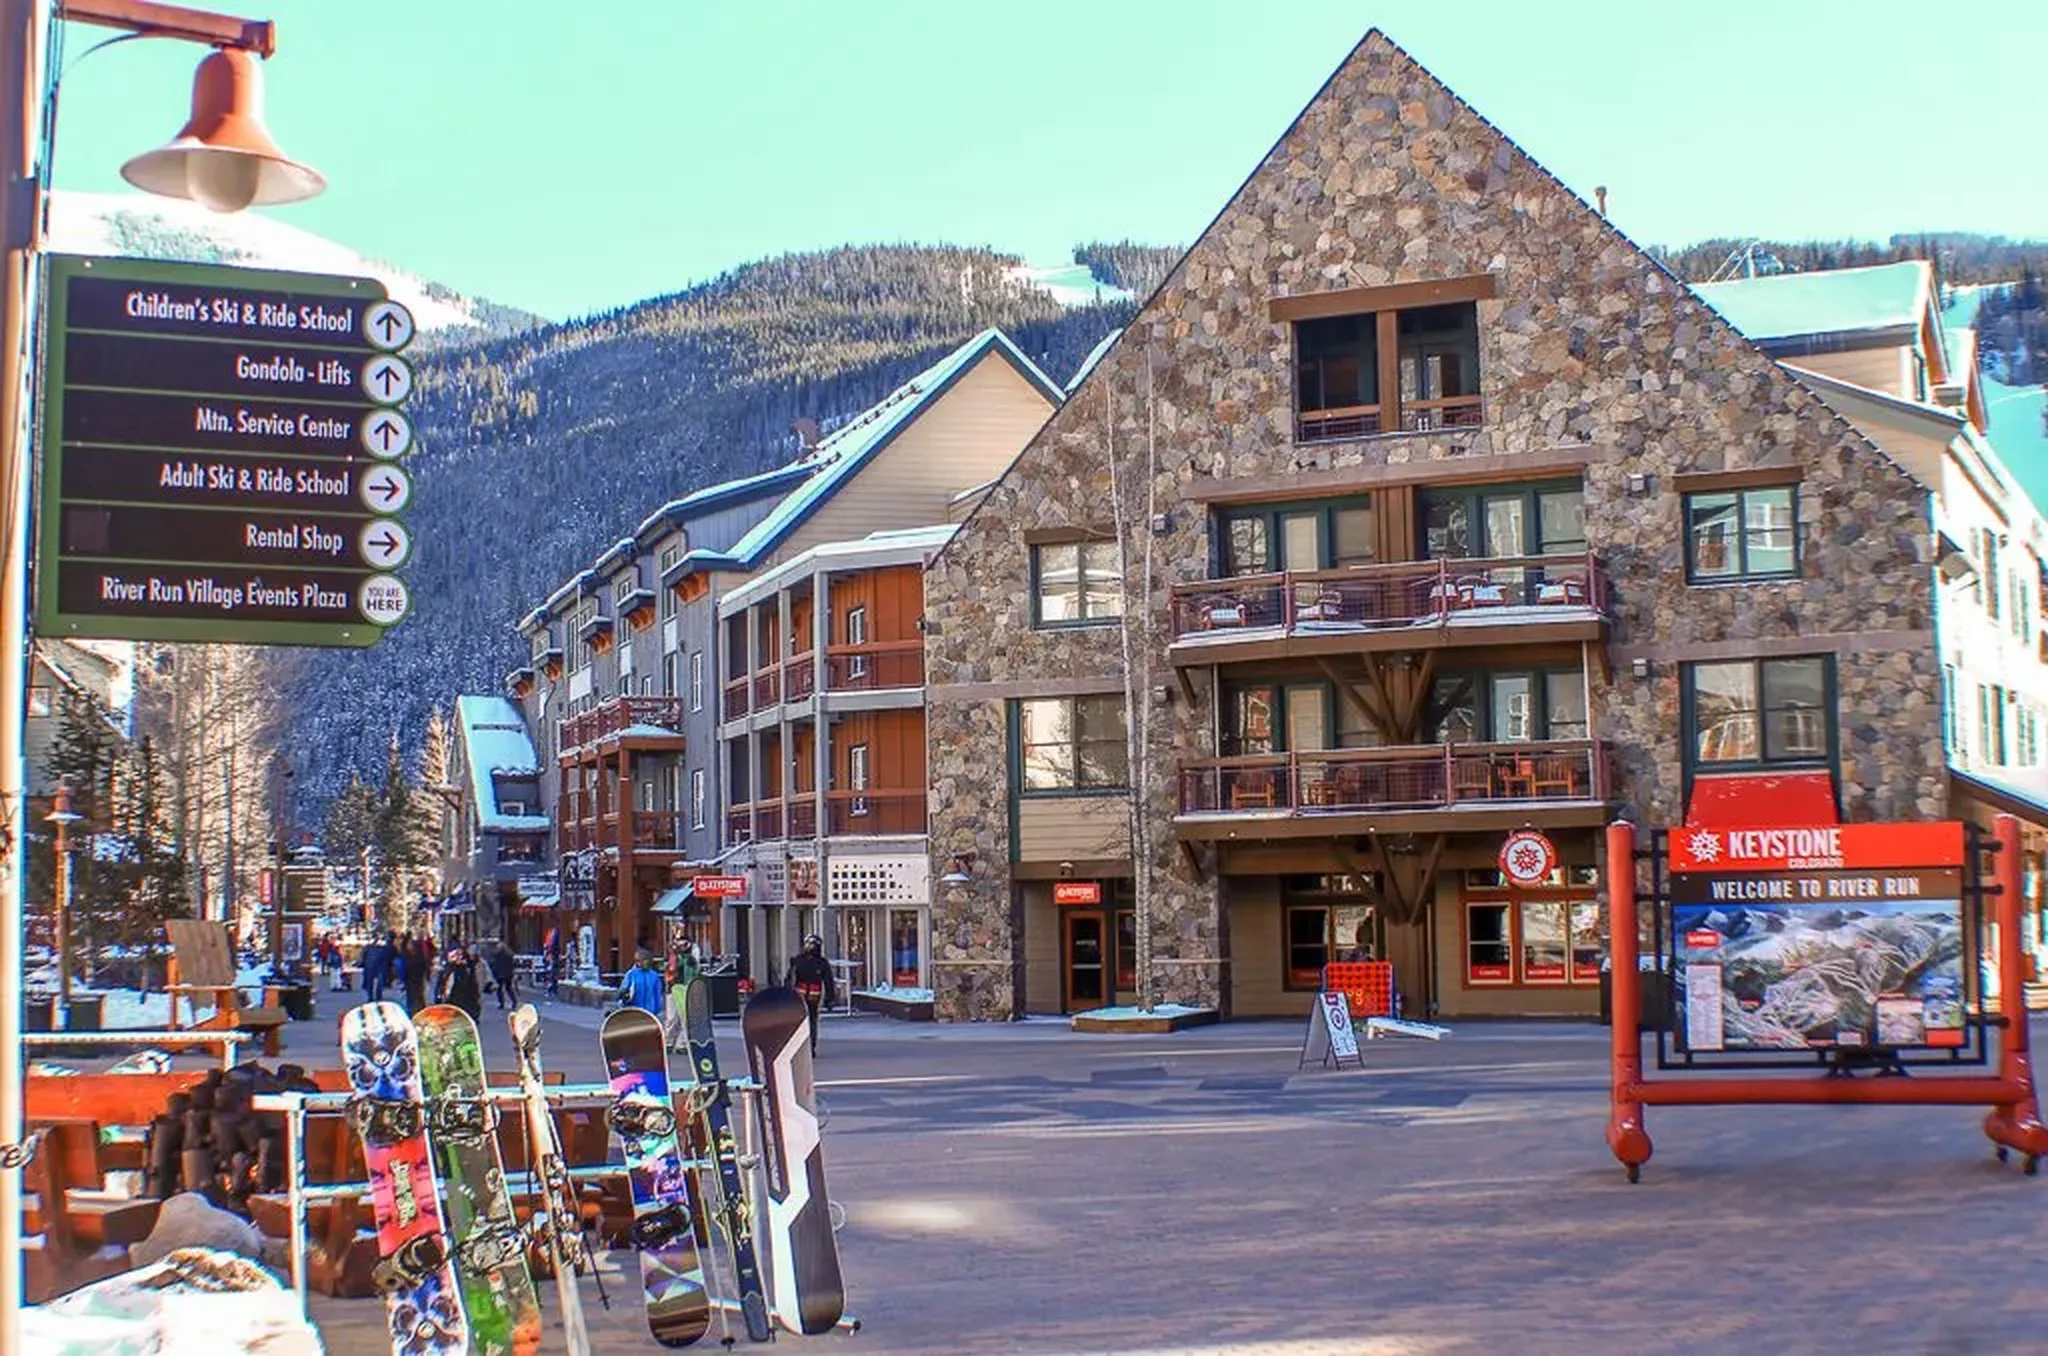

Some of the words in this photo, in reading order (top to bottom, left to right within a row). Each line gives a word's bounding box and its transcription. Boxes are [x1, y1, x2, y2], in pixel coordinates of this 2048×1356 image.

[126, 291, 209, 321] Children's
[212, 298, 238, 323] Ski
[242, 304, 257, 324] &
[260, 302, 297, 328] Ride
[299, 307, 352, 333] School
[237, 356, 304, 383] Gondola
[317, 361, 351, 386] Lifts
[196, 407, 233, 433] Mtn.
[237, 411, 294, 435] Service
[299, 415, 350, 439] Center
[160, 463, 204, 488] Adult
[207, 466, 234, 490] Ski
[238, 472, 252, 490] &
[256, 470, 293, 494] Ride
[297, 474, 349, 496] School
[246, 523, 298, 549] Rental
[302, 527, 343, 554] Shop
[102, 576, 146, 600] River
[150, 580, 182, 602] Run
[186, 580, 243, 608] Village
[247, 582, 299, 608] Events
[303, 584, 347, 608] Plaza
[366, 600, 403, 611] HERE
[367, 587, 384, 597] YOU
[1728, 829, 1842, 858] KEYSTONE
[1712, 879, 1793, 899] WELCOME
[1799, 878, 1822, 897] TO
[1828, 878, 1879, 897] RIVER
[1884, 876, 1920, 896] RUN
